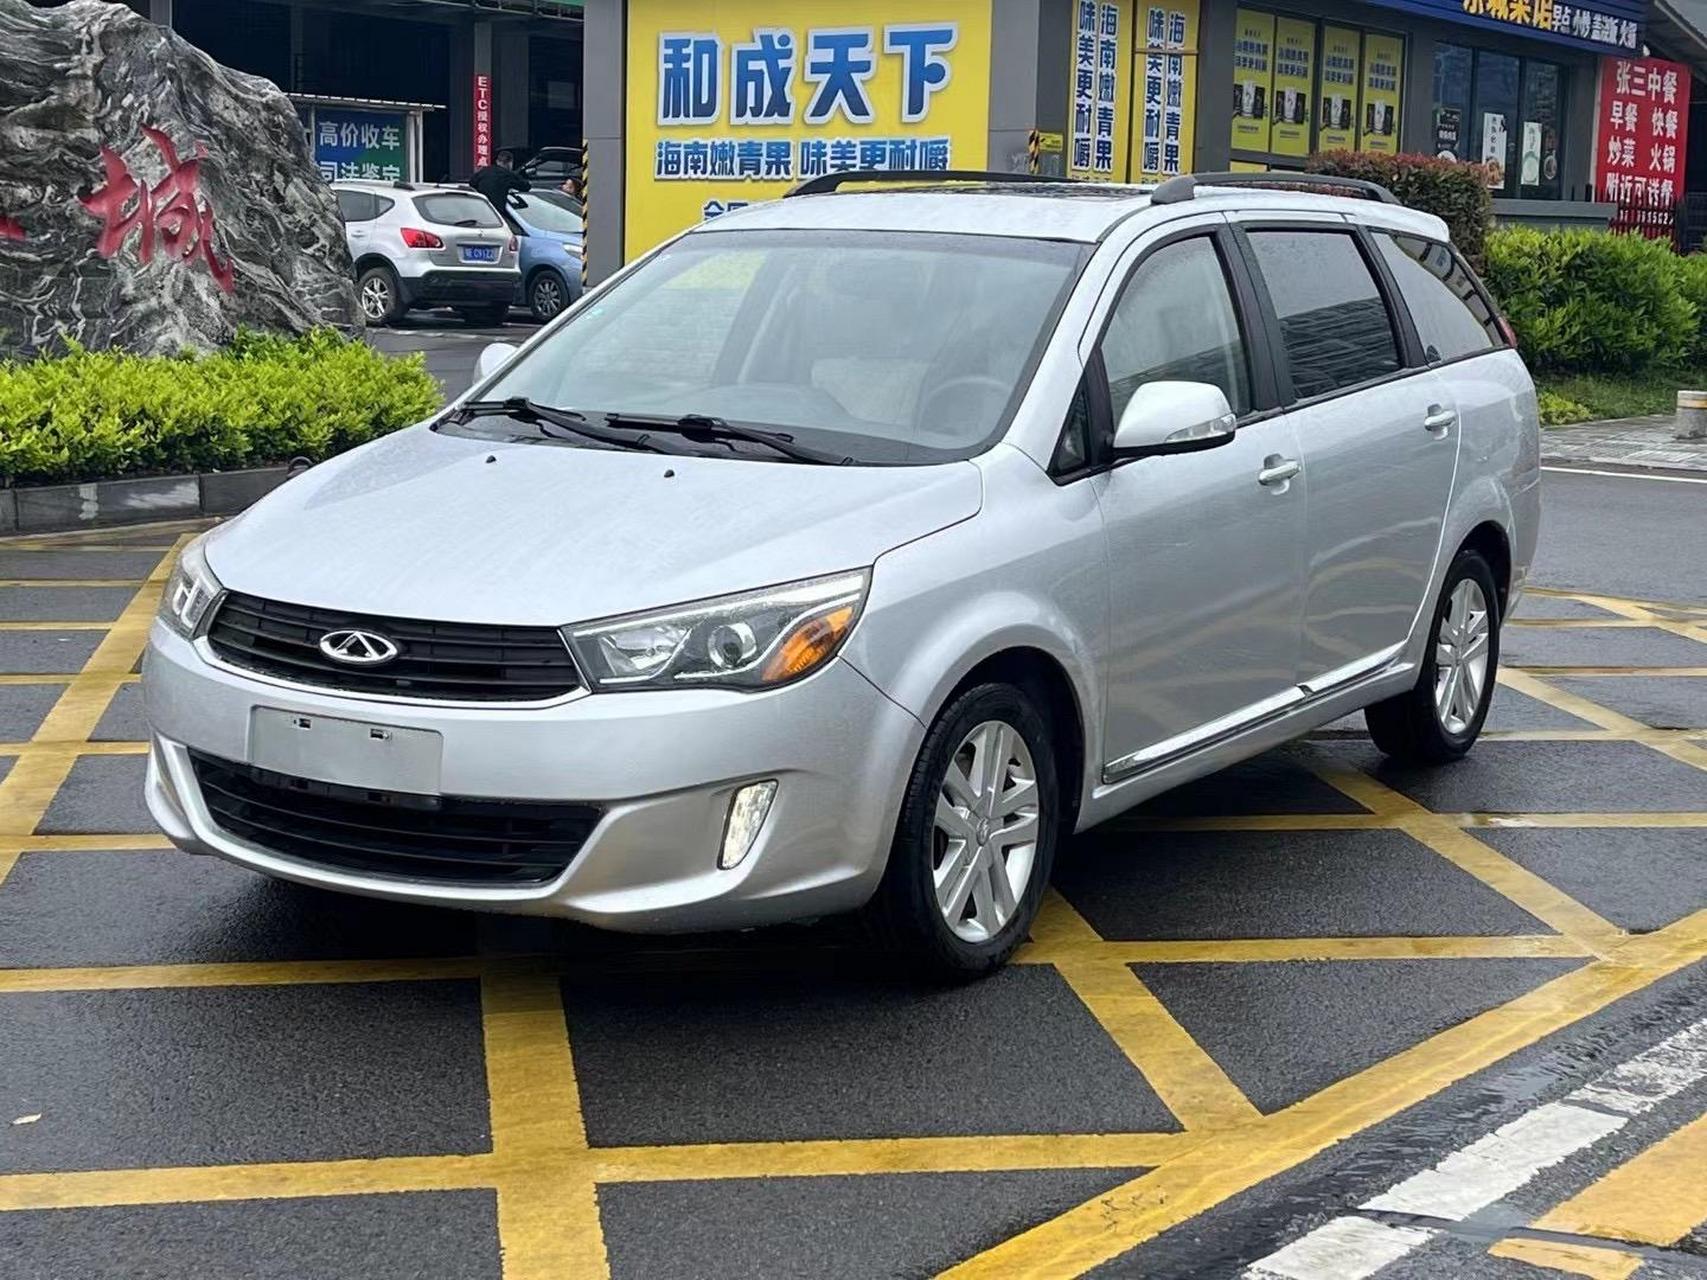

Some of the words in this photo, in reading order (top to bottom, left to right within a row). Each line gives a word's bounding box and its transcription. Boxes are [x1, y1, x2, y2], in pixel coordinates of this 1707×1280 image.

[661, 28, 955, 120] 和成天下
[1616, 61, 1678, 105] 张三中餐
[319, 121, 400, 150] 高价收车
[1610, 101, 1638, 132] 早餐
[1651, 107, 1678, 139] 快餐
[657, 140, 792, 177] 海南嫩青果
[800, 138, 950, 176] 味美更耐嚼
[1607, 136, 1636, 168] 炒菜
[1649, 143, 1675, 173] 火锅
